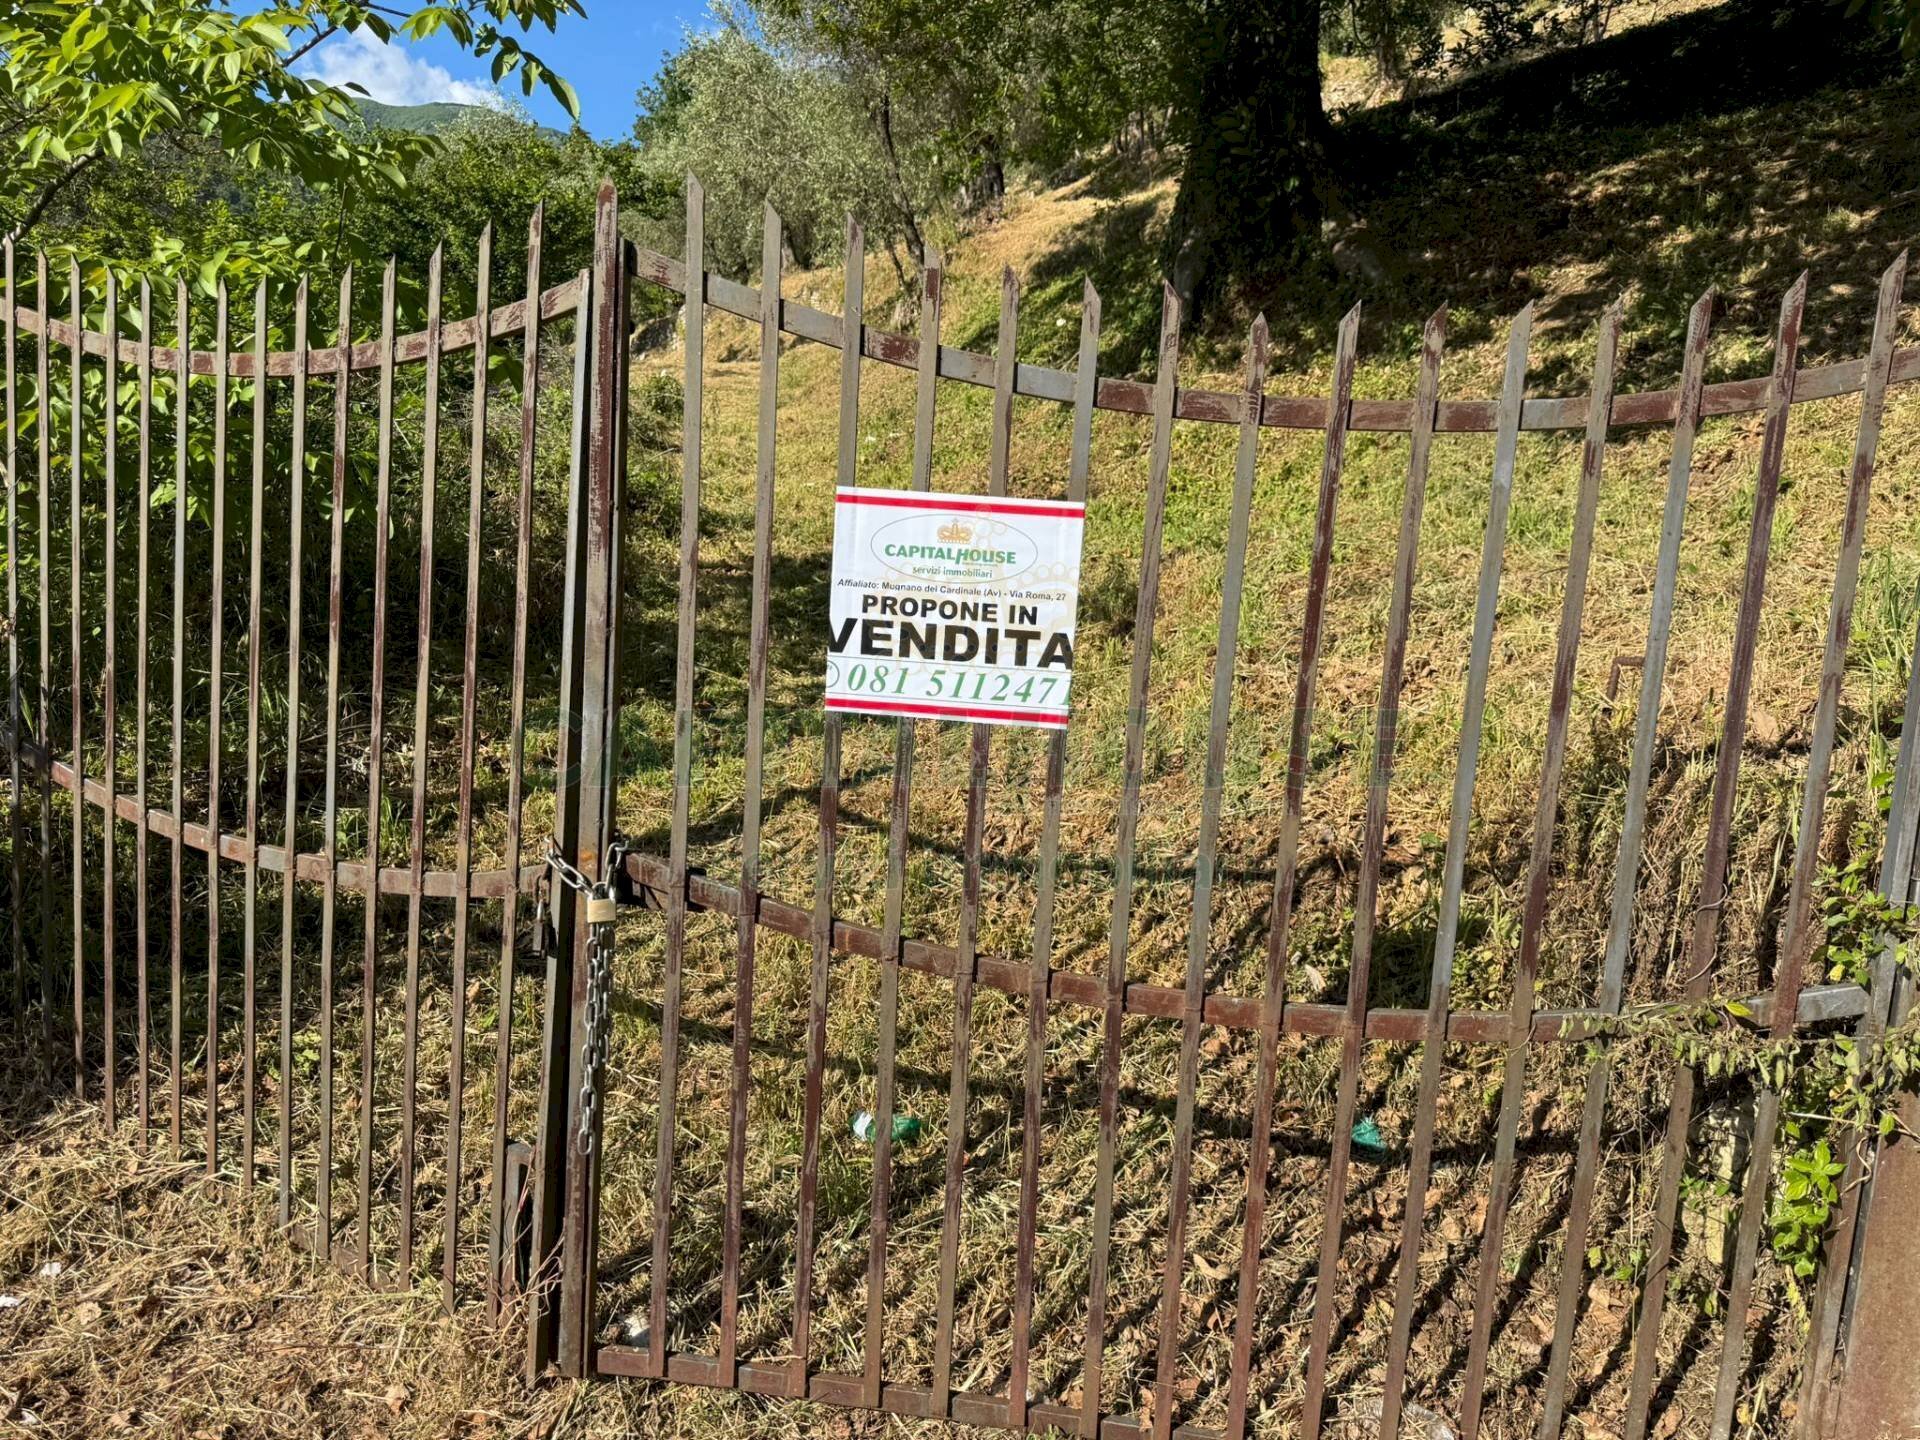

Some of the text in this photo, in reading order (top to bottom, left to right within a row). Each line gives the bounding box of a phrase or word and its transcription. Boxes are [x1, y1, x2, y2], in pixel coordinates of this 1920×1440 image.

[912, 566, 993, 578] servizi immobiliari
[939, 584, 981, 596] Cardinale
[983, 588, 1001, 598] (Av)
[1009, 590, 1023, 598] Via
[1025, 591, 1054, 602] Roma,
[1056, 592, 1067, 601] 27
[862, 594, 1038, 625] PROPONE IN
[829, 618, 1073, 670] VENDITA
[847, 664, 909, 694] 081
